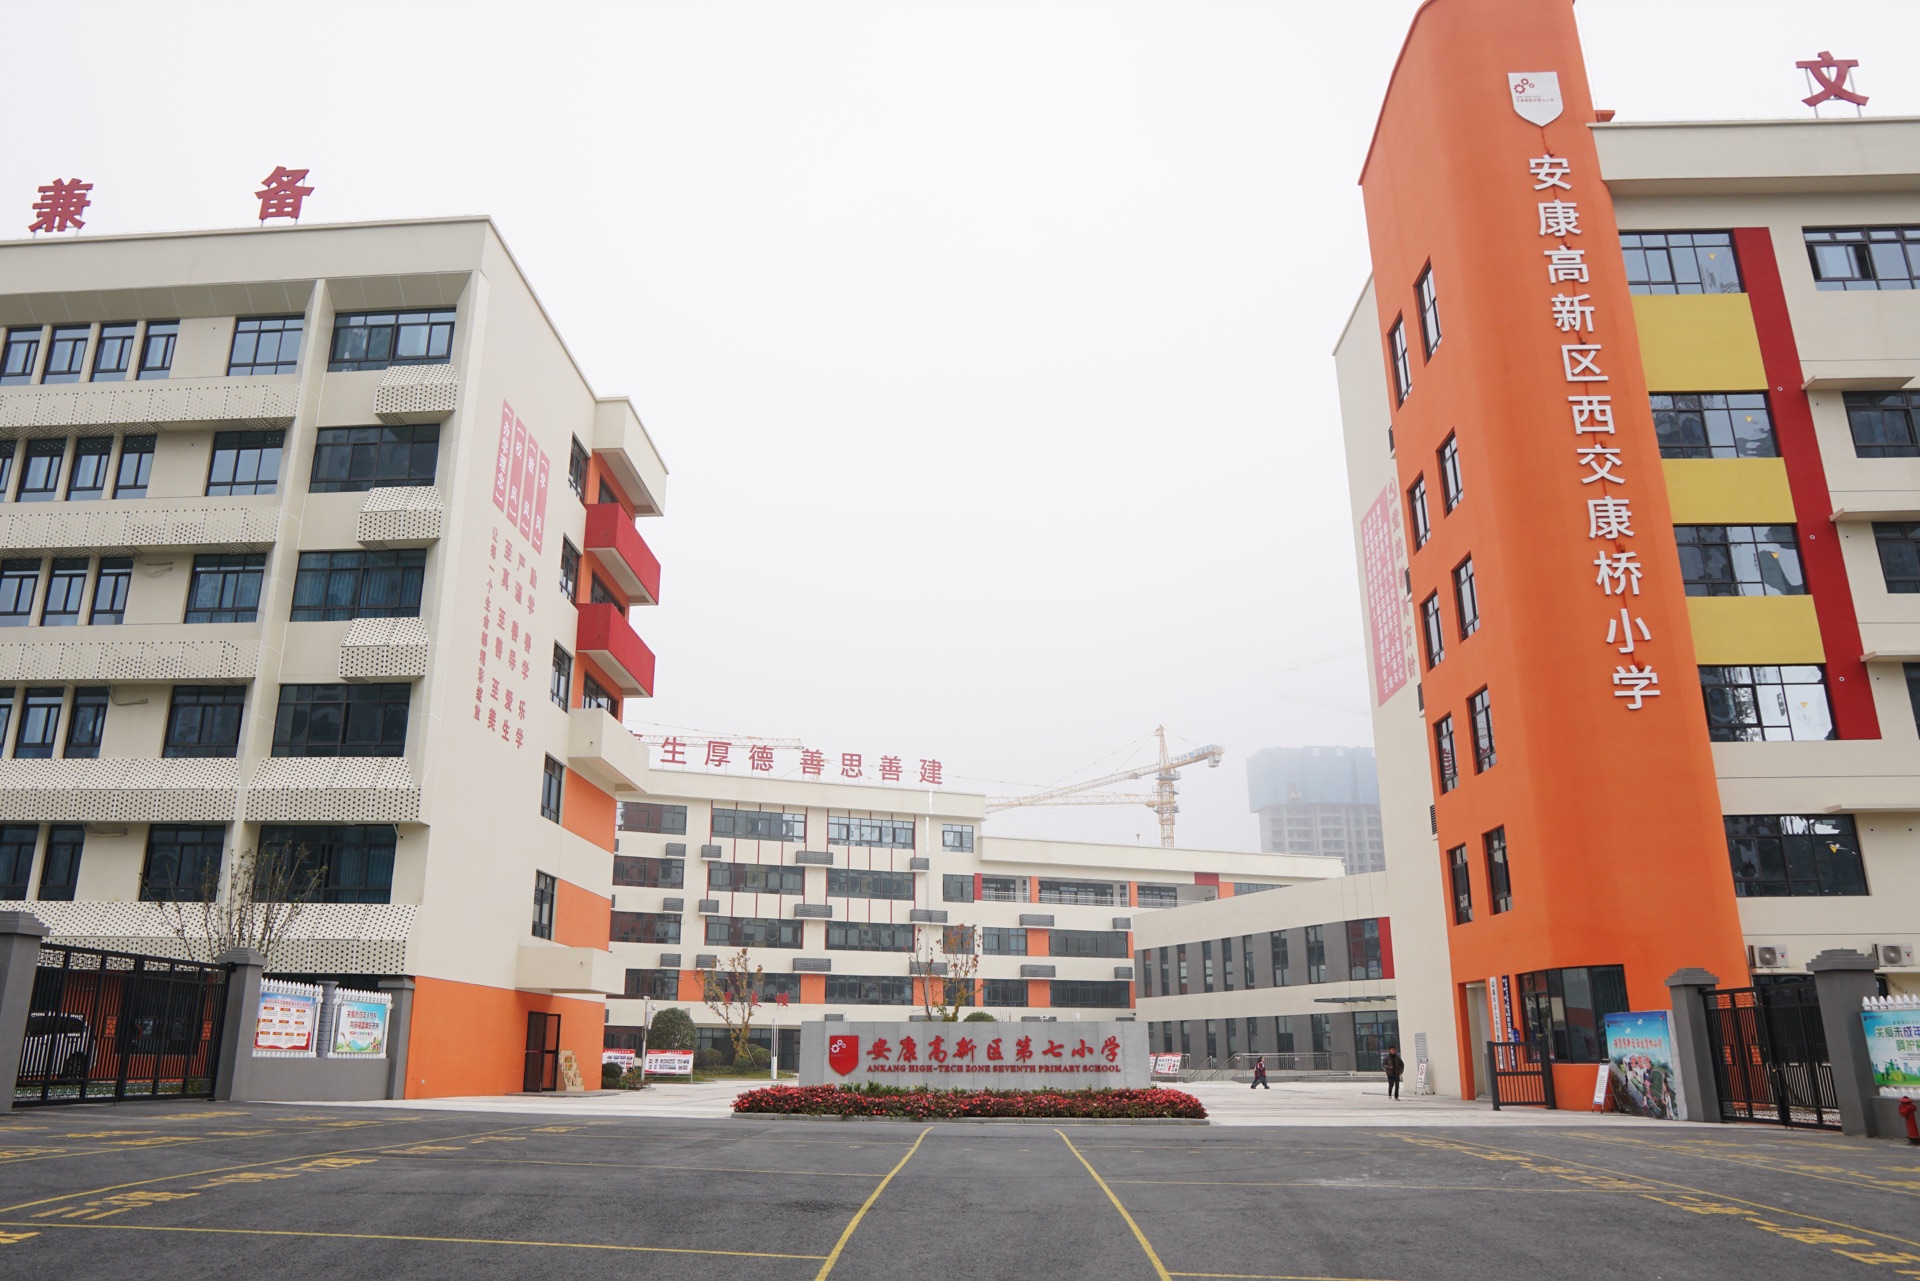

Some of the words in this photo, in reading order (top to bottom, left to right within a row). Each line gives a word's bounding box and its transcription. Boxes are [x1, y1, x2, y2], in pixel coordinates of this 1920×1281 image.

[1795, 51, 1870, 107] 文
[1528, 154, 1661, 710] 安康高新区西交康桥小学
[1391, 507, 1416, 678] 党的教育方针
[633, 734, 775, 772] 生厚德
[866, 1035, 1122, 1064] 安康高新区第七小学
[866, 1064, 907, 1073] ANKANG
[908, 1064, 963, 1073] HIGH-TECH
[965, 1064, 991, 1073] ZONE
[992, 1064, 1036, 1073] SEVENTH
[1038, 1064, 1081, 1073] PRIMARY
[1082, 1064, 1121, 1073] SCHOOL
